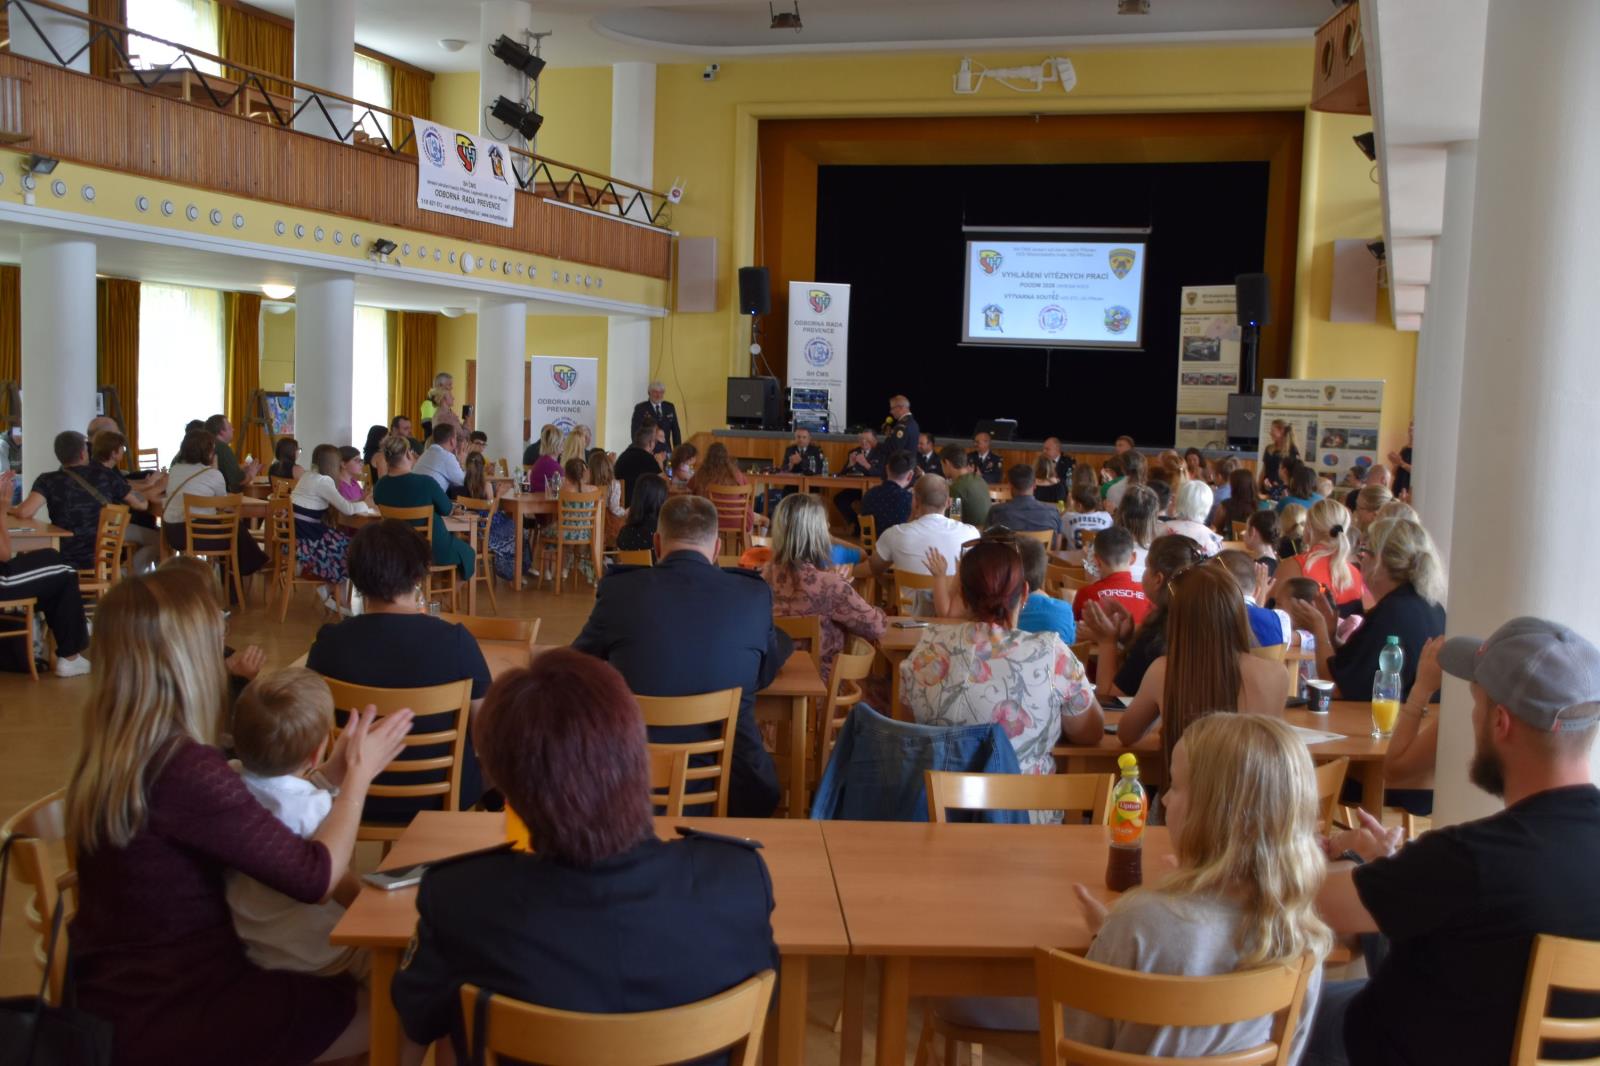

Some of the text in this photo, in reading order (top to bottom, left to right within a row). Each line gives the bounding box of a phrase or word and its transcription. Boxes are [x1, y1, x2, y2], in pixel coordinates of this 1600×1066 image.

[434, 189, 460, 201] ODBORNÁ
[462, 195, 476, 204] RADA
[477, 198, 501, 210] PREVENCE
[1086, 272, 1109, 280] PRACÍ
[1098, 588, 1145, 600] PORSCHE
[1120, 802, 1140, 811] Lipton
